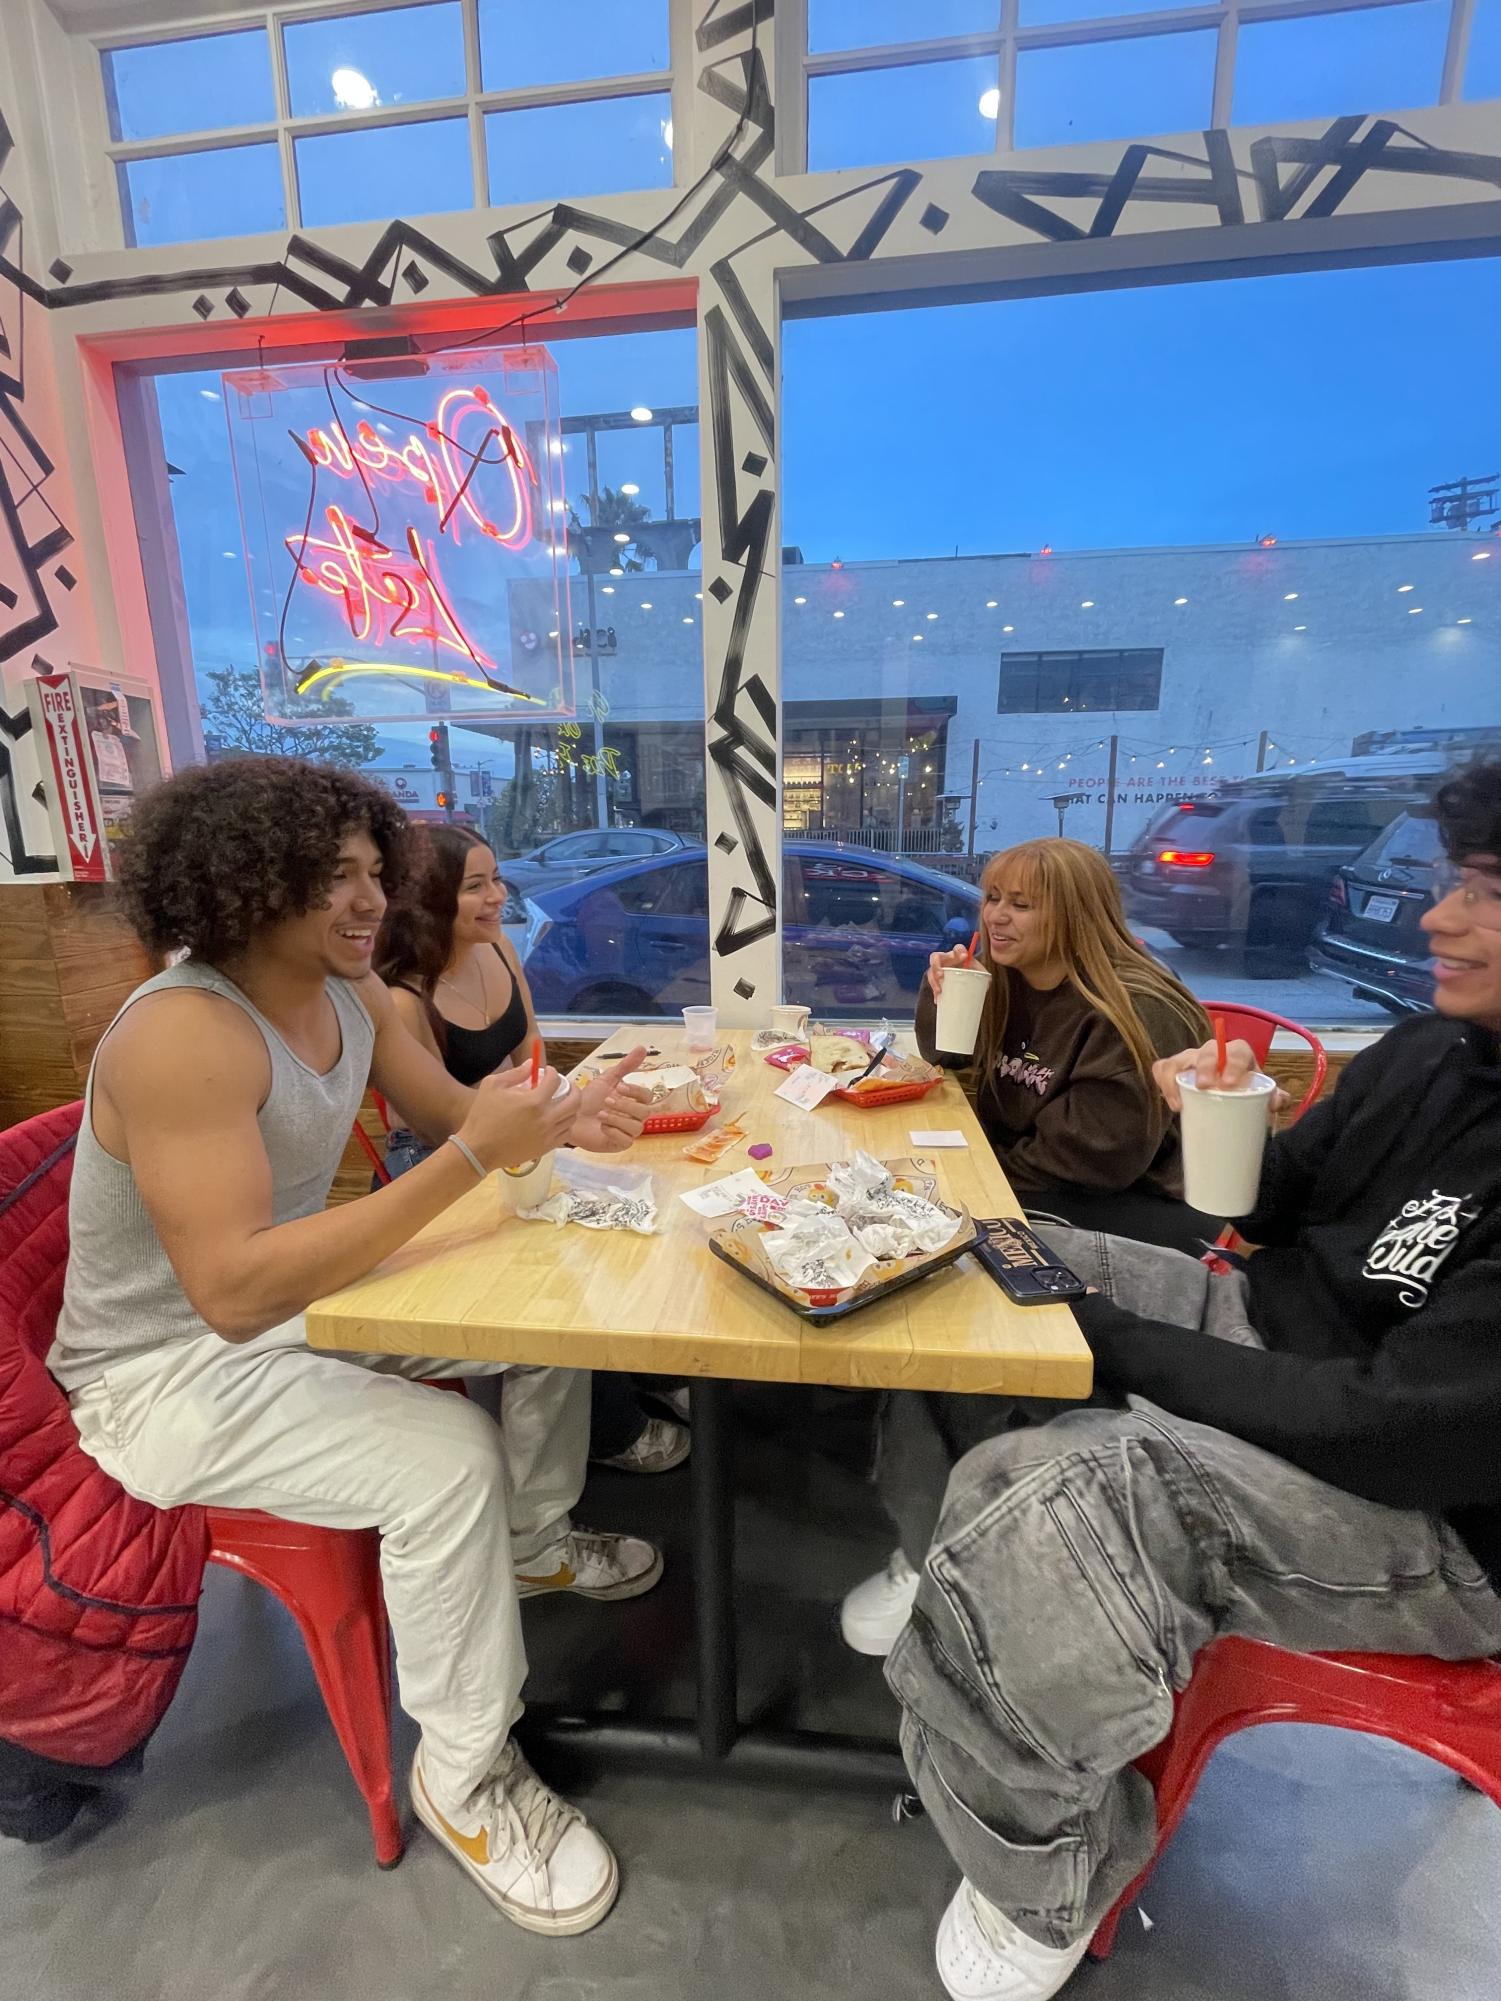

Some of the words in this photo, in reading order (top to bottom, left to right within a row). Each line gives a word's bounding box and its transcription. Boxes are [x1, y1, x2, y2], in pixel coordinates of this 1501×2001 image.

[43, 691, 72, 712] FIRE
[1126, 776, 1153, 787] ARE
[1160, 775, 1186, 787] THE
[1097, 793, 1128, 804] CN
